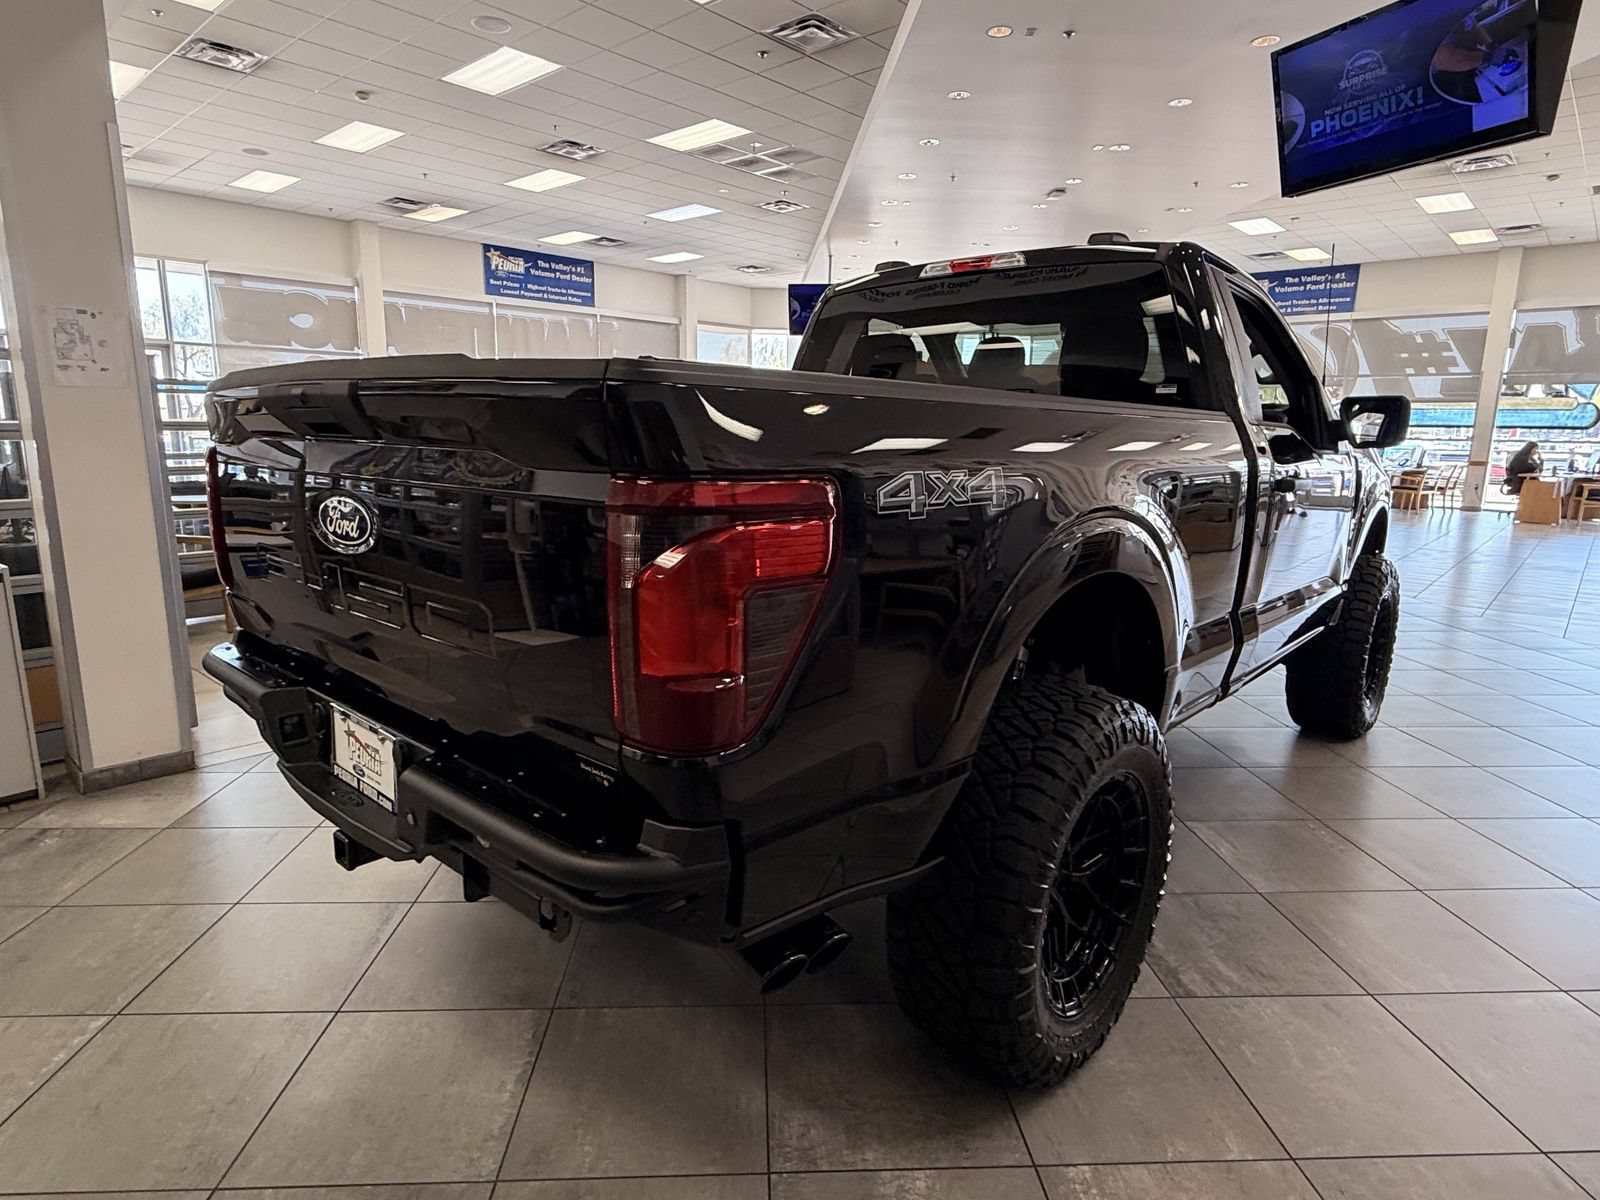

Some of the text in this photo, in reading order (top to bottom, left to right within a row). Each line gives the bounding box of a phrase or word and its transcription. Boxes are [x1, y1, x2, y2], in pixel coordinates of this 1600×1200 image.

[1338, 65, 1388, 90] SURPRISE
[1311, 86, 1424, 138] PHOENIX!
[1324, 106, 1341, 116] NOW
[537, 260, 585, 274] The Valley's #1
[530, 268, 555, 278] Volume
[556, 272, 571, 281] Ford
[571, 275, 592, 284] Dealer
[1284, 276, 1299, 284] The
[1335, 272, 1347, 280] #1
[1306, 282, 1325, 290] Ford
[326, 502, 360, 538] Ford
